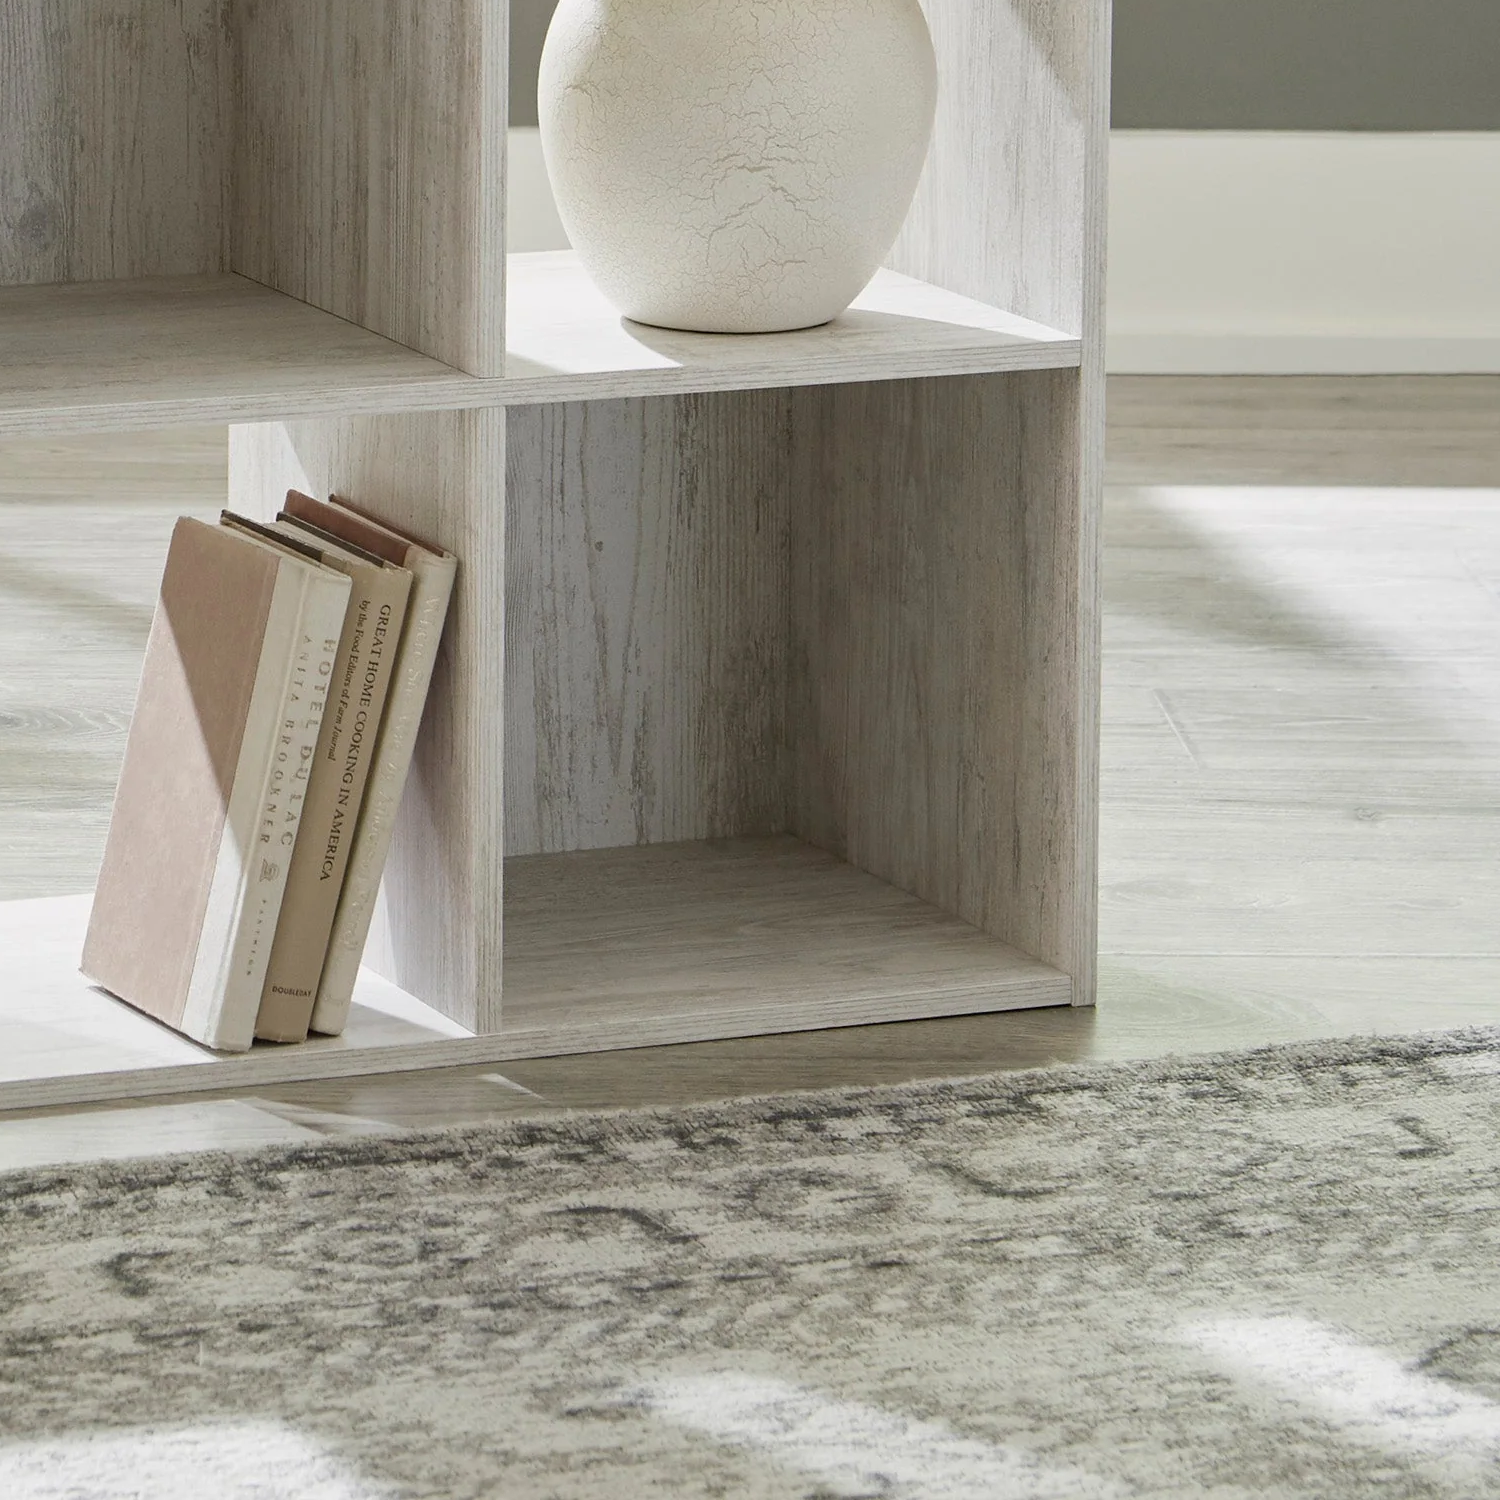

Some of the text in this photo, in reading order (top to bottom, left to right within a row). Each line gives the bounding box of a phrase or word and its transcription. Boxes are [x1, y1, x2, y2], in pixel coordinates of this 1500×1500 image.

[258, 634, 313, 844] ANITA BROOKNER
[279, 638, 336, 847] HOTEL DU LAC
[319, 603, 391, 882] GREAT HOME COOKING IN AMERICA
[327, 599, 369, 761] by the Food Editors of Farm Journal
